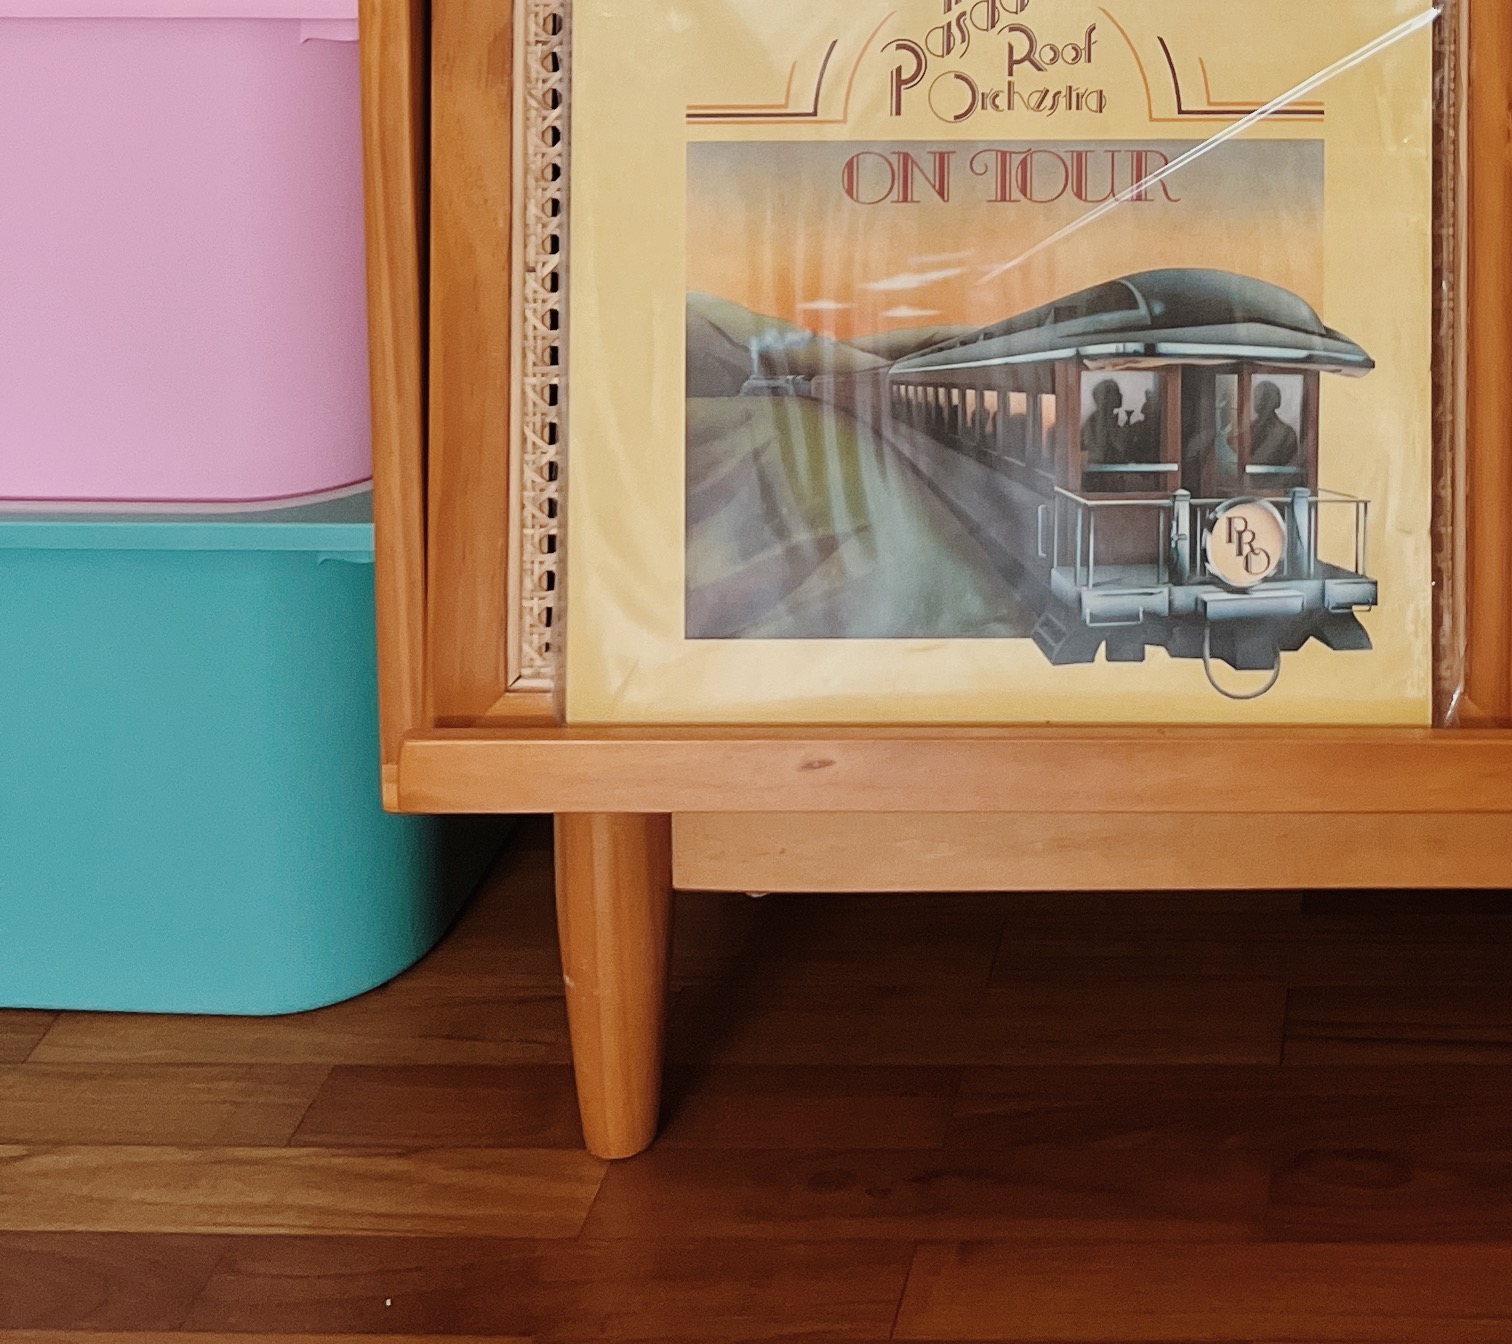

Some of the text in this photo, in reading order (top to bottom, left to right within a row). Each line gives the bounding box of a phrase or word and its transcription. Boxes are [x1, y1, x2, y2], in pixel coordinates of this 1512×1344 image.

[997, 23, 1098, 77] Roof
[928, 70, 1107, 124] Orchestra
[841, 148, 1182, 205] ON TOUR
